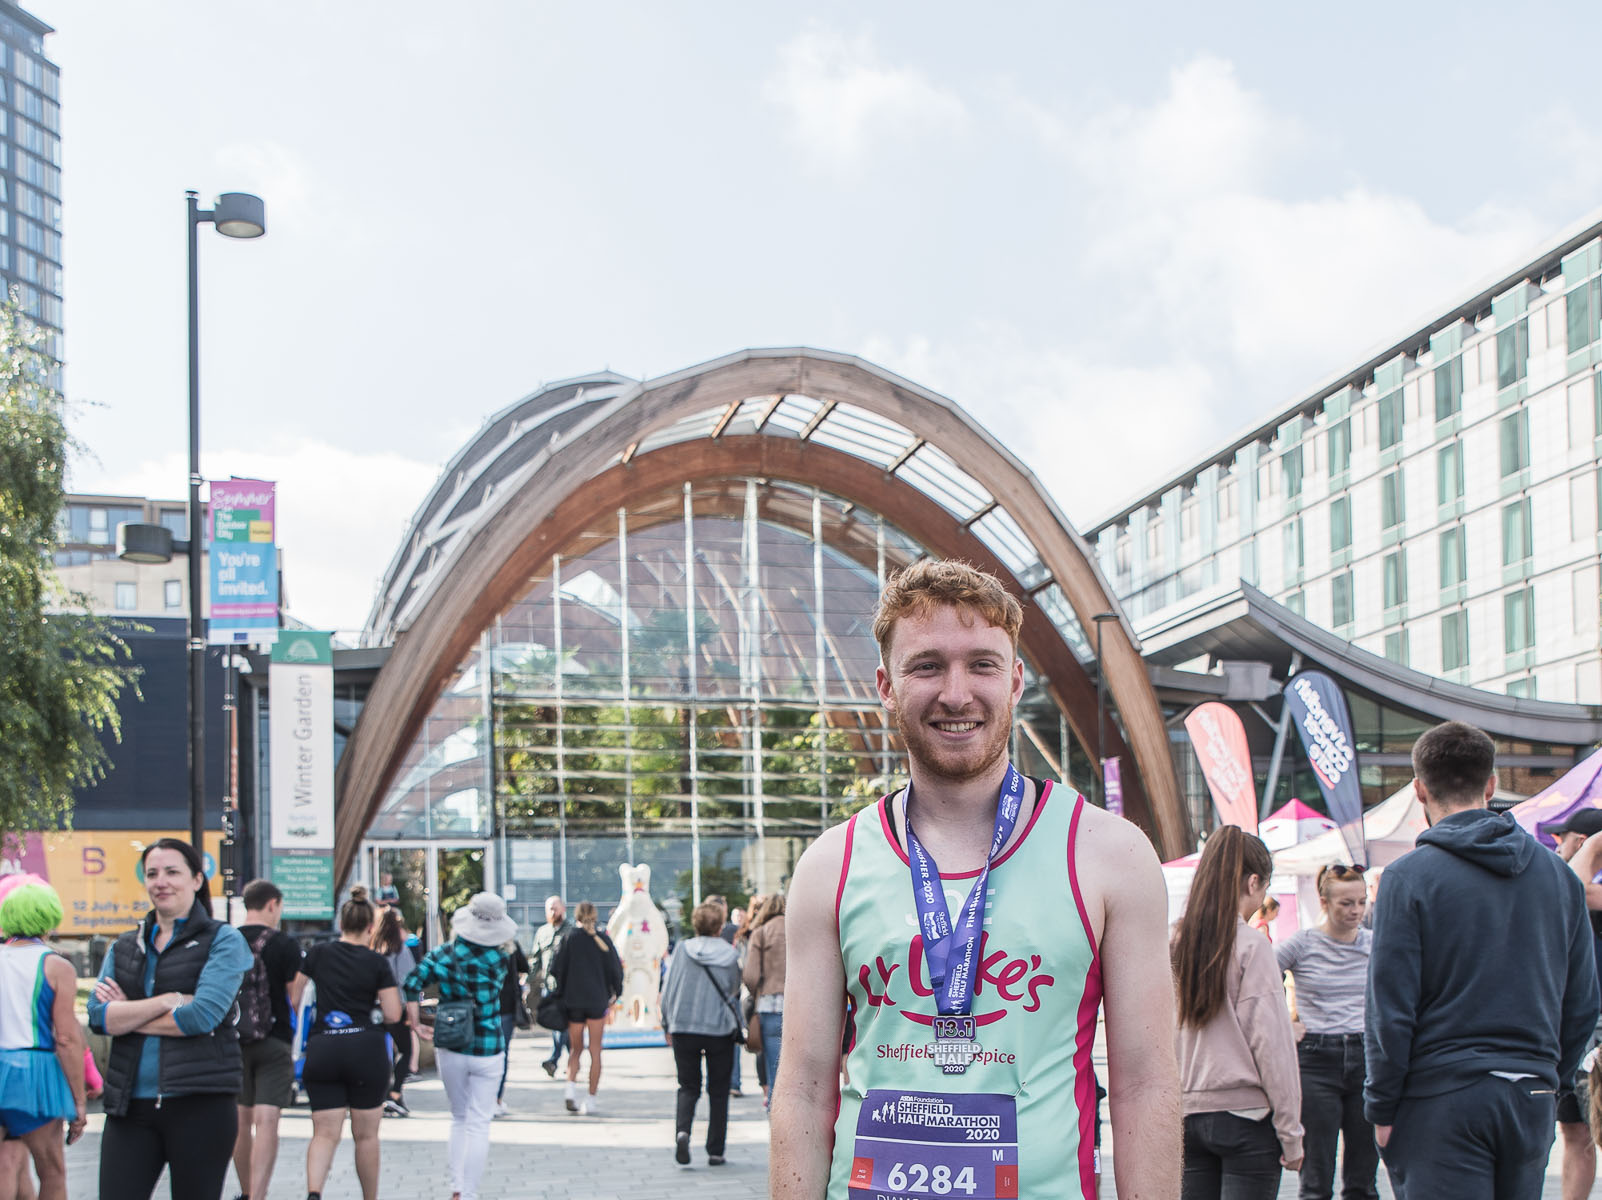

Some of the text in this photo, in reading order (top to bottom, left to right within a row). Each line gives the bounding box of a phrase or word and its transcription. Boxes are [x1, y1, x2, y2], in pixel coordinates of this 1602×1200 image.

[218, 551, 261, 567] You're
[217, 567, 236, 581] all
[218, 580, 269, 596] invited.
[293, 673, 312, 741] Garden
[294, 747, 312, 807] Winter
[922, 880, 935, 904] 2020
[73, 900, 87, 910] 12
[91, 900, 118, 913] July
[73, 915, 139, 929] Septemb
[908, 930, 1055, 1012] Lke's
[958, 936, 975, 998] HALF MARATHON
[952, 963, 963, 998] SHEFFIELD
[936, 1019, 973, 1038] 13.1
[928, 1044, 980, 1053] SHEFFIELD
[935, 1053, 973, 1065] HALF
[973, 1048, 1016, 1067] spice
[944, 1065, 965, 1073] 2020
[914, 1096, 944, 1104] Foundation
[898, 1102, 951, 1115] SHEFFIELD
[898, 1113, 999, 1127] HALF MARATHON
[966, 1128, 1000, 1140] 2020
[992, 1149, 1004, 1161] M
[887, 1162, 977, 1195] 6284
